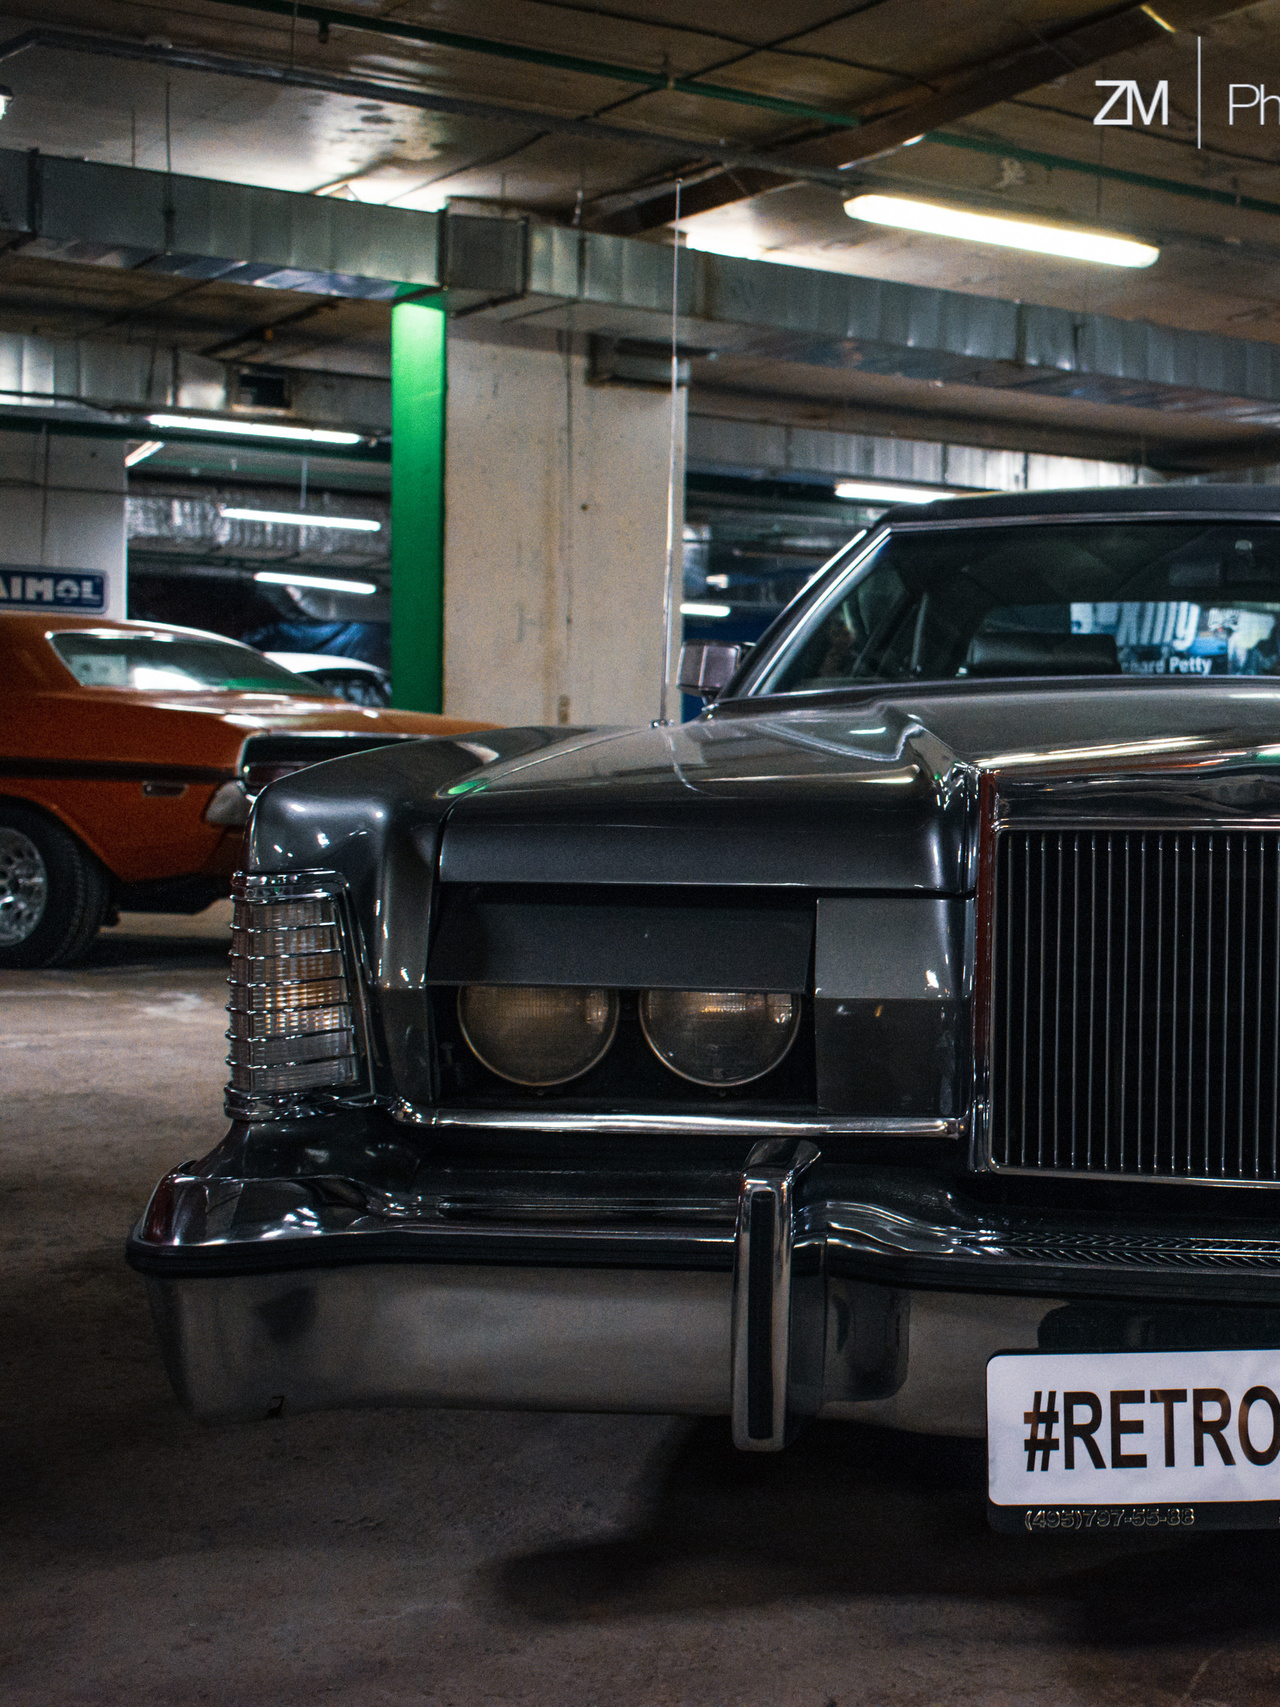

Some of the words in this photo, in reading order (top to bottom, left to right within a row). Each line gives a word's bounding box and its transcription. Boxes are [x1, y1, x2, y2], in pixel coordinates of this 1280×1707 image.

[1121, 655, 1166, 674] chard
[1168, 655, 1212, 676] Petty
[1024, 1507, 1196, 1531] (495)797-55-88
